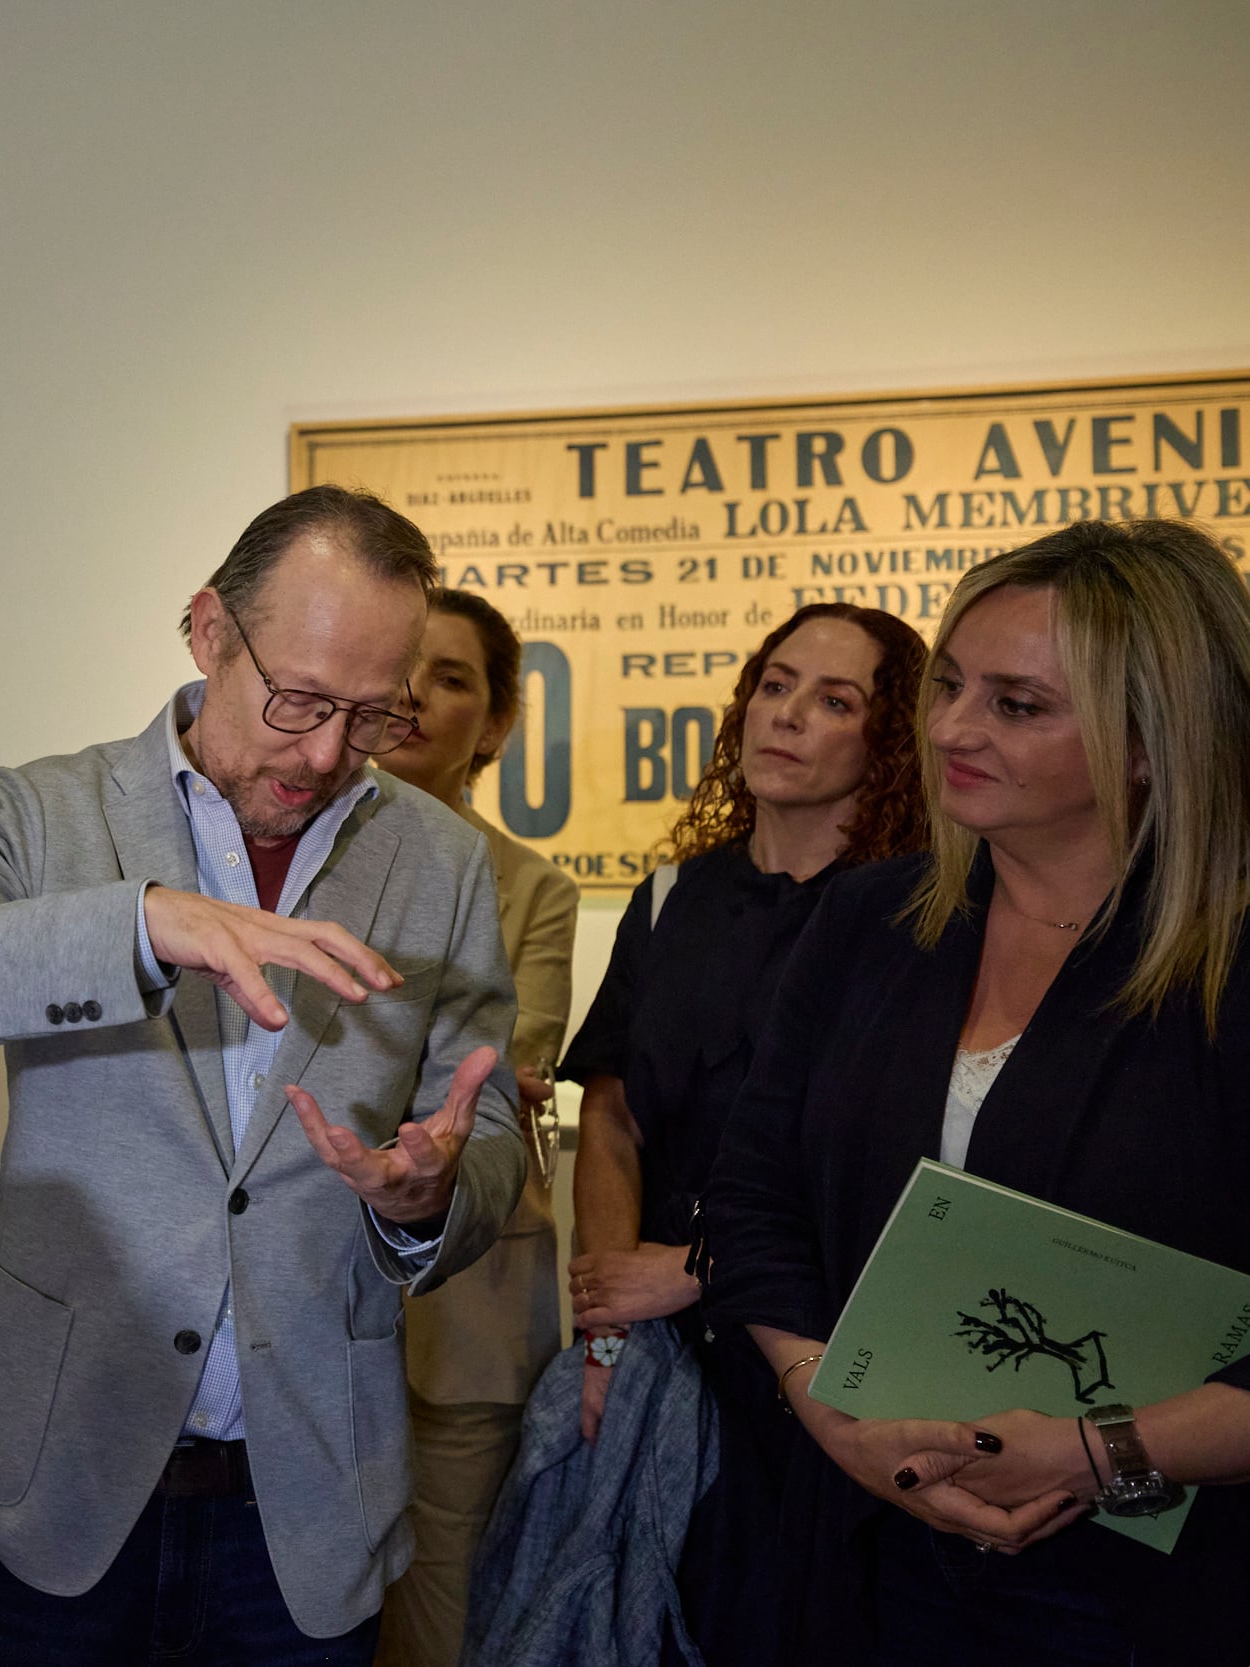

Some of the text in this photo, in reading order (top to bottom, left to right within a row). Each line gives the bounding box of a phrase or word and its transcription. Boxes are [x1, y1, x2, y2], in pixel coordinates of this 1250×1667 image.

[566, 408, 1241, 498] TEATRO AVENI
[508, 522, 533, 546] de
[542, 519, 589, 546] Alta
[596, 516, 700, 543] Comedia
[723, 497, 869, 539] LOLA
[902, 478, 1250, 531] MEMBRIVE
[678, 557, 718, 582] 21
[742, 554, 787, 579] DE
[616, 611, 644, 631] en
[659, 603, 728, 629] Honor
[745, 602, 772, 627] de
[622, 652, 754, 678] REP
[928, 1197, 952, 1221] EN
[843, 1348, 873, 1391] VALS
